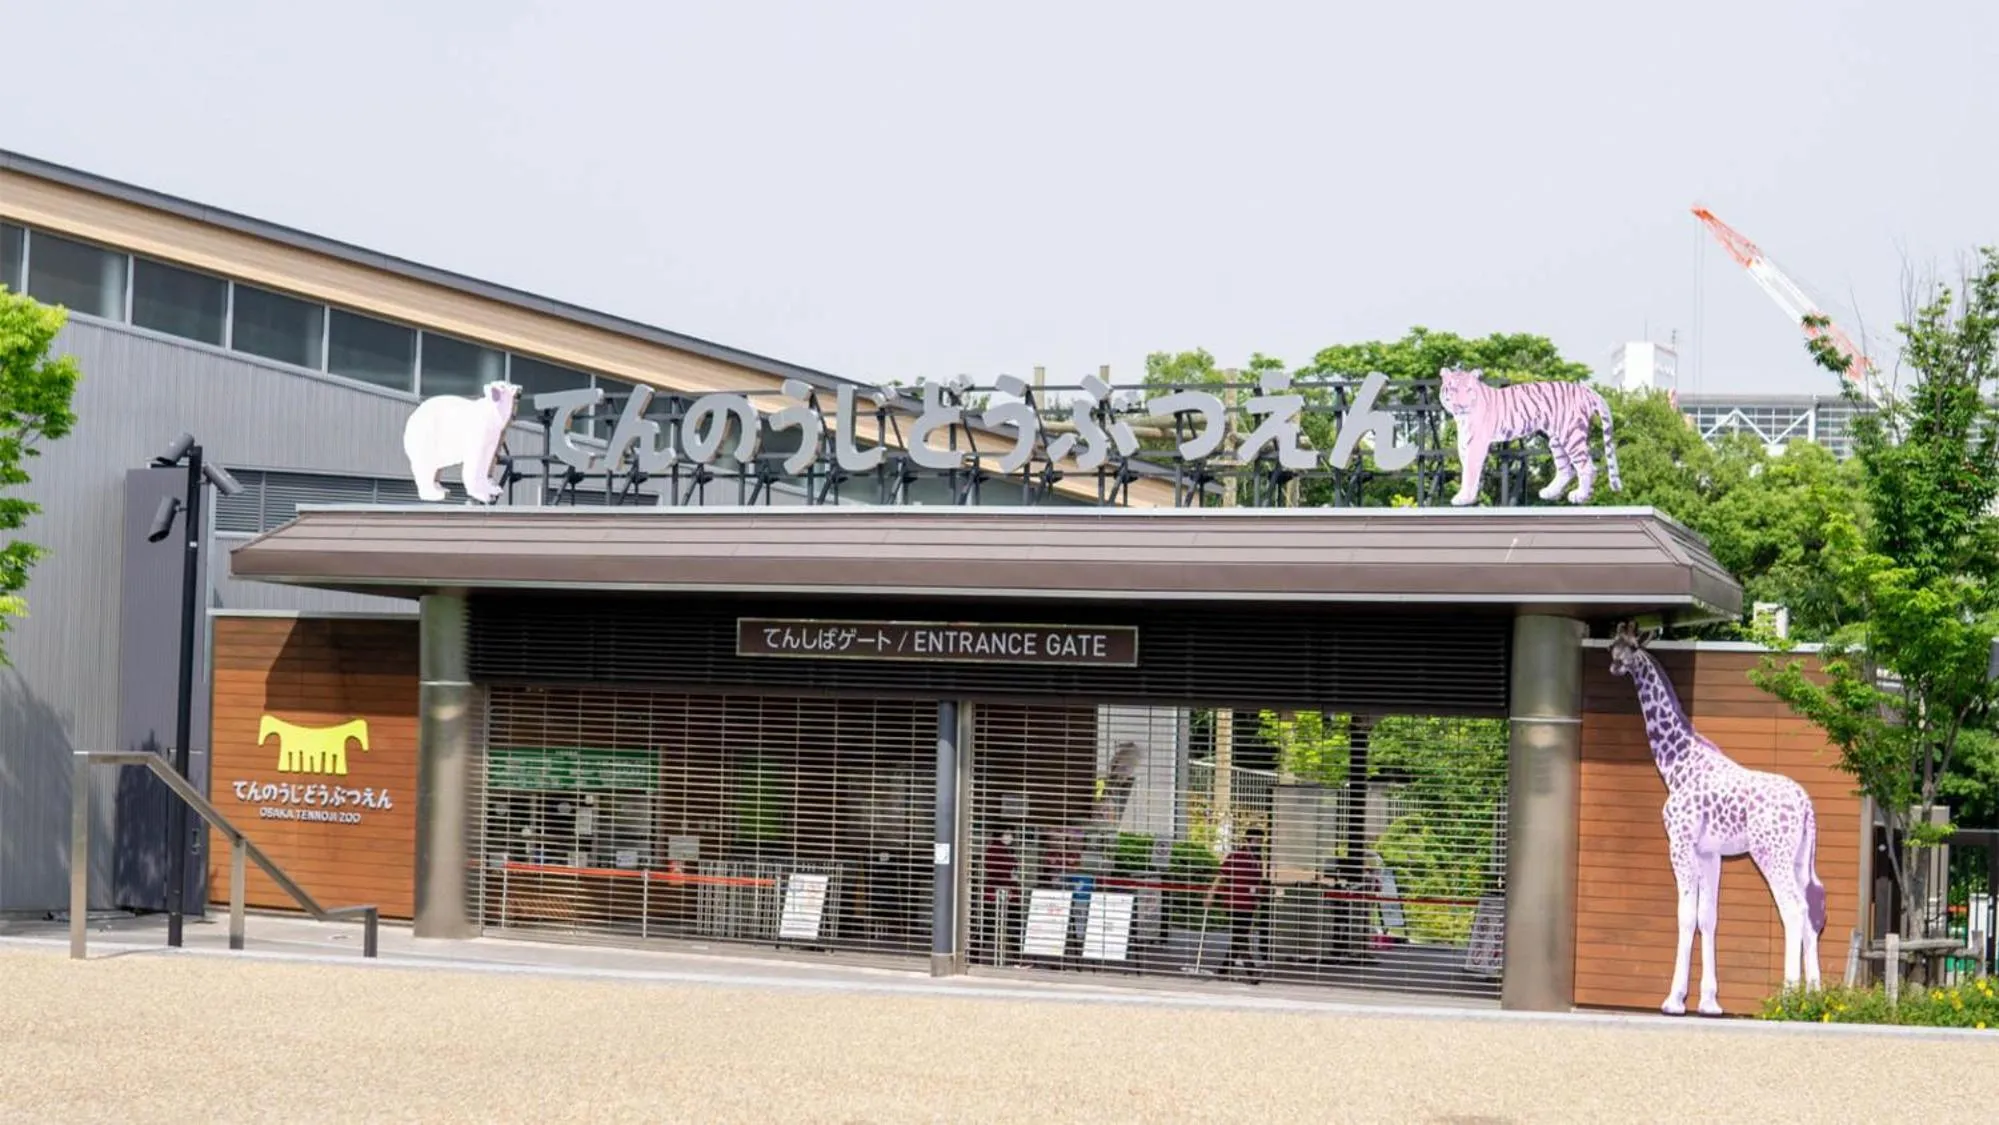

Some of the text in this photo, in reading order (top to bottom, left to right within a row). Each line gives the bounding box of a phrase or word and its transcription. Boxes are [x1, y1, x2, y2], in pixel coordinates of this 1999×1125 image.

[534, 371, 1418, 474] てんのうじどうぶつえん
[763, 627, 892, 652] てんしばゲート
[914, 631, 1037, 655] ENTRANCE
[1046, 634, 1107, 657] GATE
[232, 780, 393, 810] てんのうじどうぶつえん
[260, 807, 361, 824] OSAKA TENNOJI ZOO
